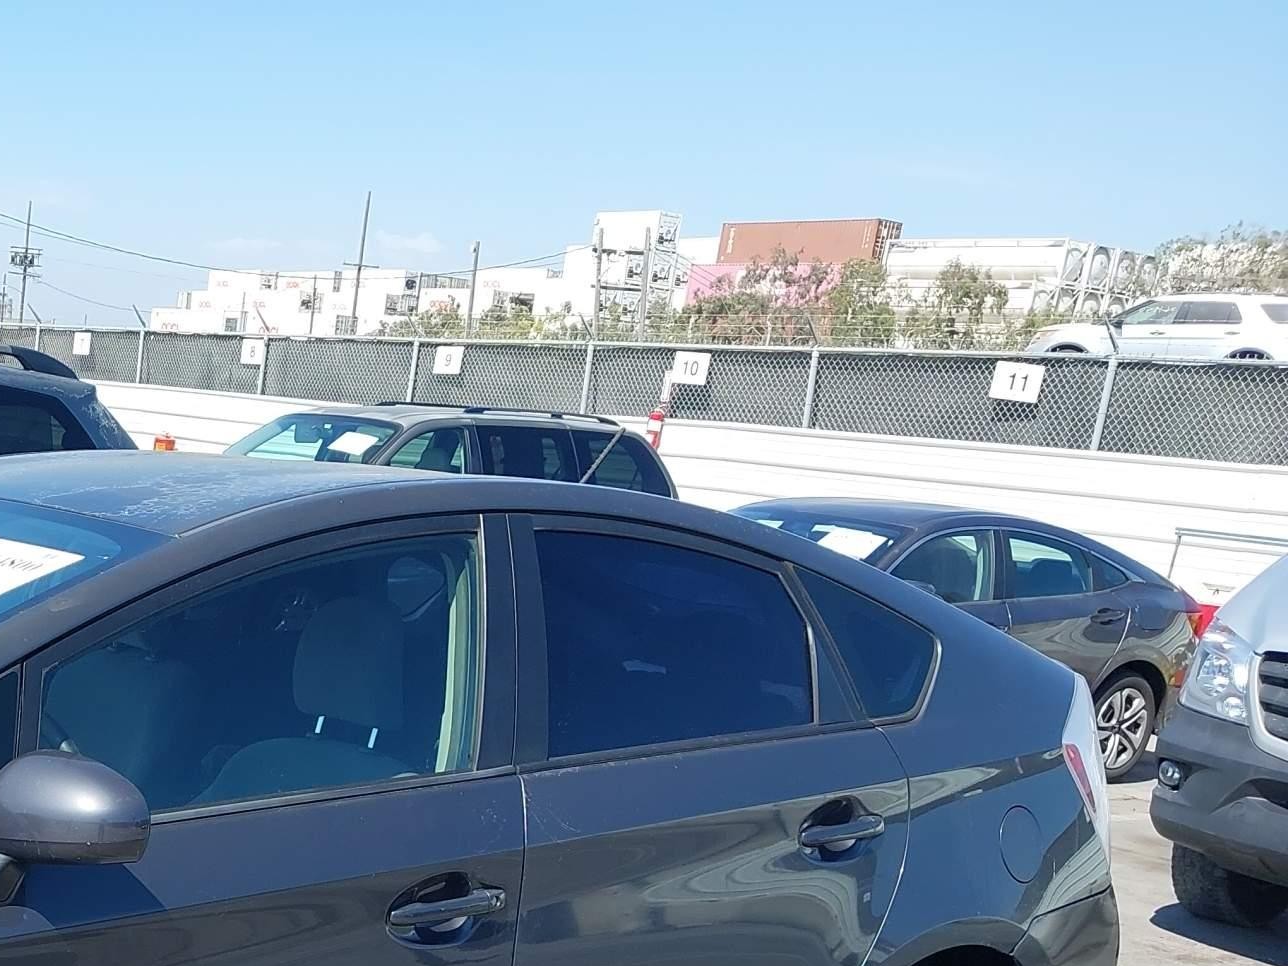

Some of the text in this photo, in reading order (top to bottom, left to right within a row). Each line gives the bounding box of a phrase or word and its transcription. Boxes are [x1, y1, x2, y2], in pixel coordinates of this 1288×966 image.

[444, 353, 452, 367] 9
[683, 360, 699, 376] 10
[1008, 373, 1029, 392] 11
